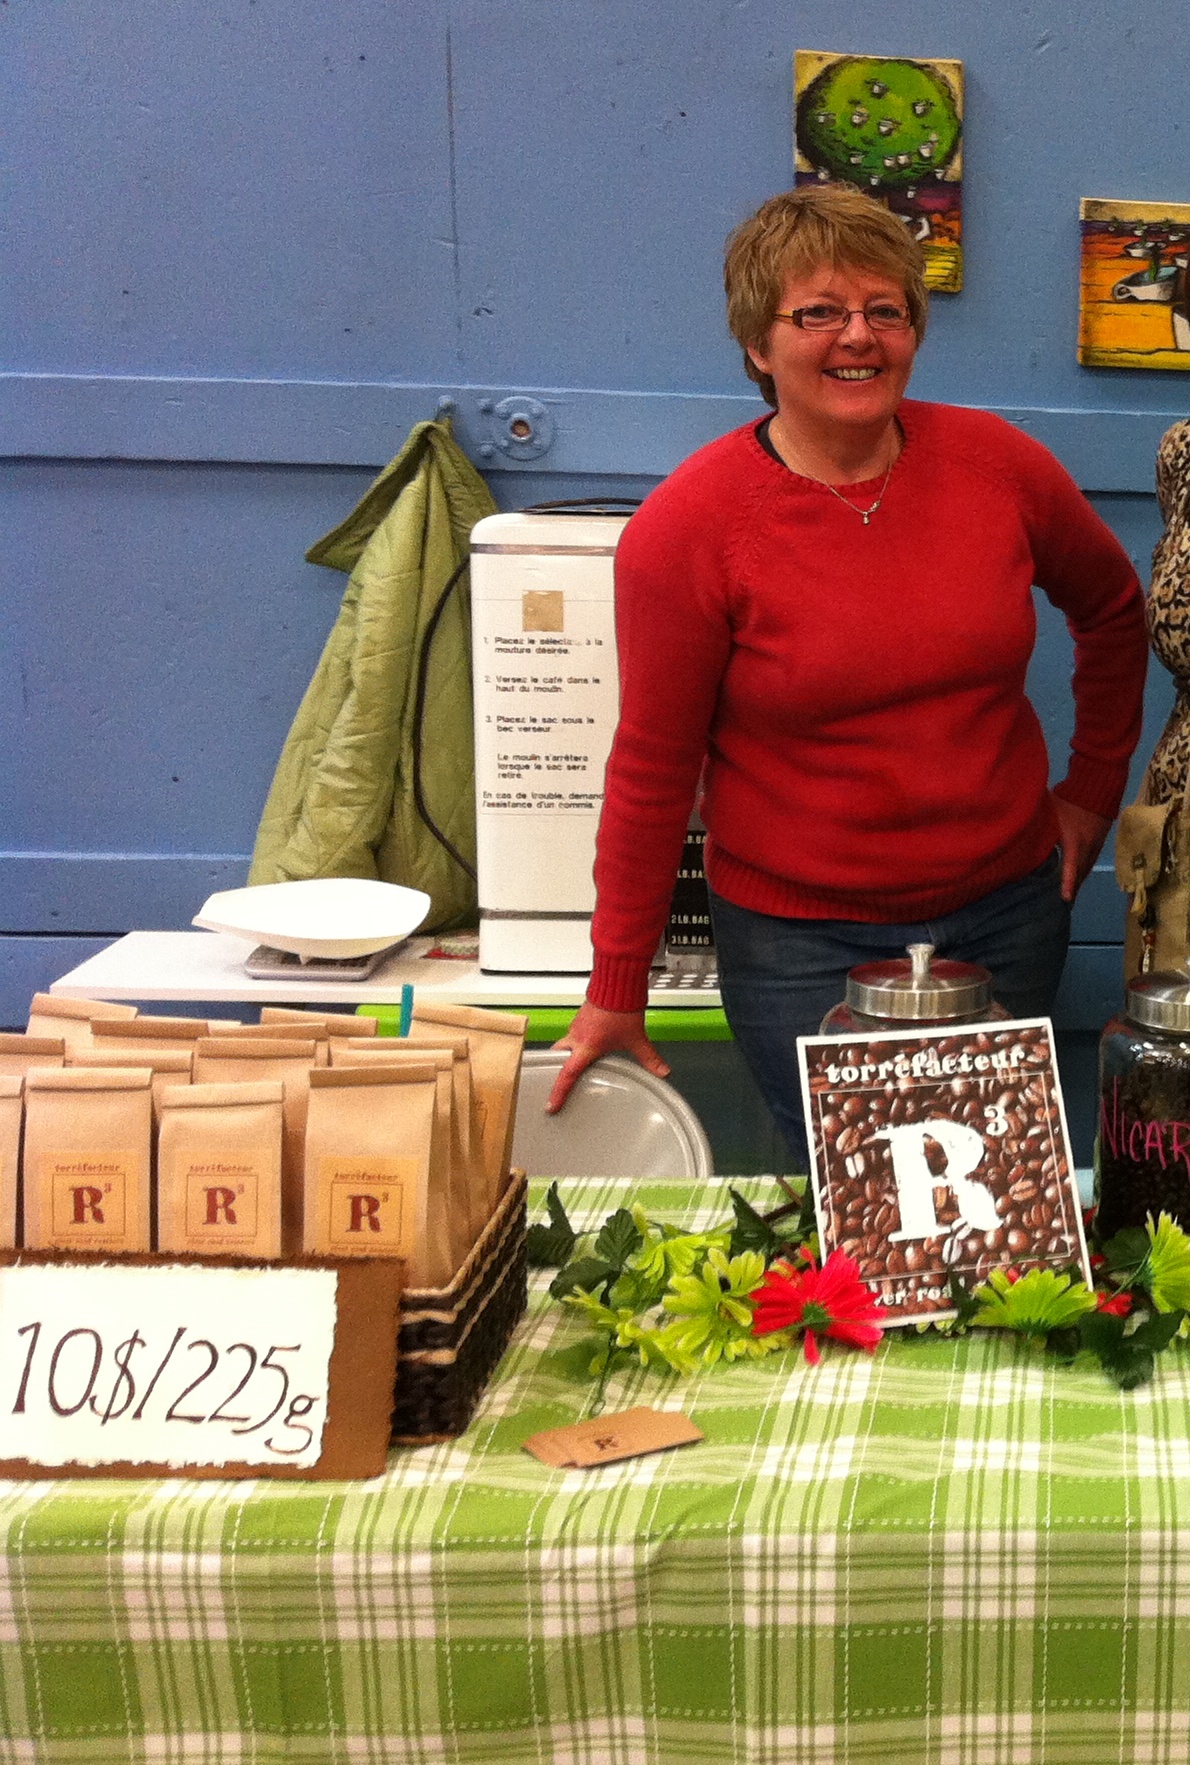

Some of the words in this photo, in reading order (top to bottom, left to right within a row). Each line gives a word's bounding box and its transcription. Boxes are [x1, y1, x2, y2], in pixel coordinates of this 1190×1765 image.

[494, 646, 532, 654] mouture
[495, 684, 515, 693] haut
[496, 725, 514, 733] bec
[497, 753, 509, 761] Le
[512, 753, 541, 761] moulin
[515, 791, 527, 799] de
[12, 1321, 321, 1454] 10$/225g
